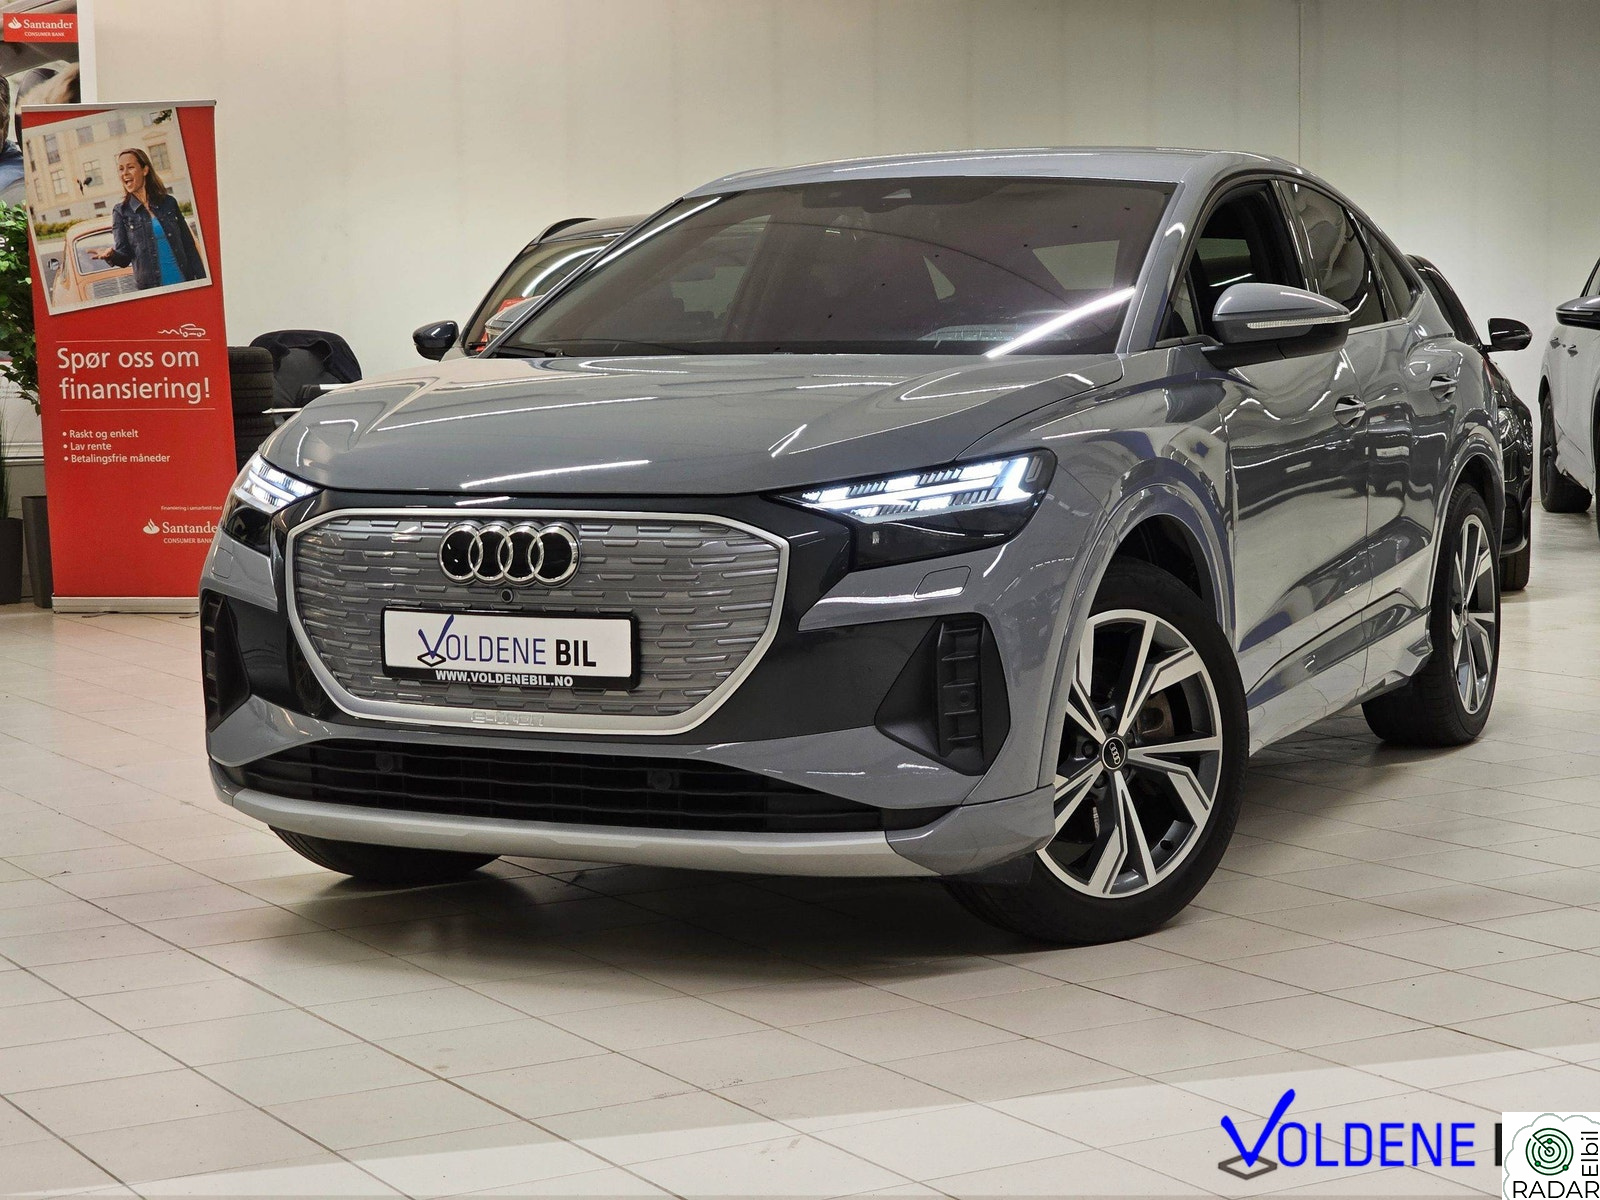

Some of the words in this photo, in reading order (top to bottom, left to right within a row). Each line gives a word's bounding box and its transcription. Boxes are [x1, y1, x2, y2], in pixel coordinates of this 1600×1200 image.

[23, 19, 73, 29] Santander
[57, 347, 110, 374] Spør
[118, 351, 154, 368] oss
[161, 350, 199, 368] om
[59, 376, 210, 404] finansiering!
[69, 429, 93, 438] Raskt
[95, 431, 108, 440] og
[109, 429, 139, 438] enkelt
[70, 442, 85, 451] Lav
[87, 442, 112, 451] rente
[71, 454, 128, 465] Betalingsfrie
[130, 454, 170, 462] måneder
[162, 520, 218, 534] Santande
[418, 614, 546, 665] VOLDENE
[555, 639, 597, 667] BIL
[435, 670, 574, 687] WWW.VOLDENEBIL.NO
